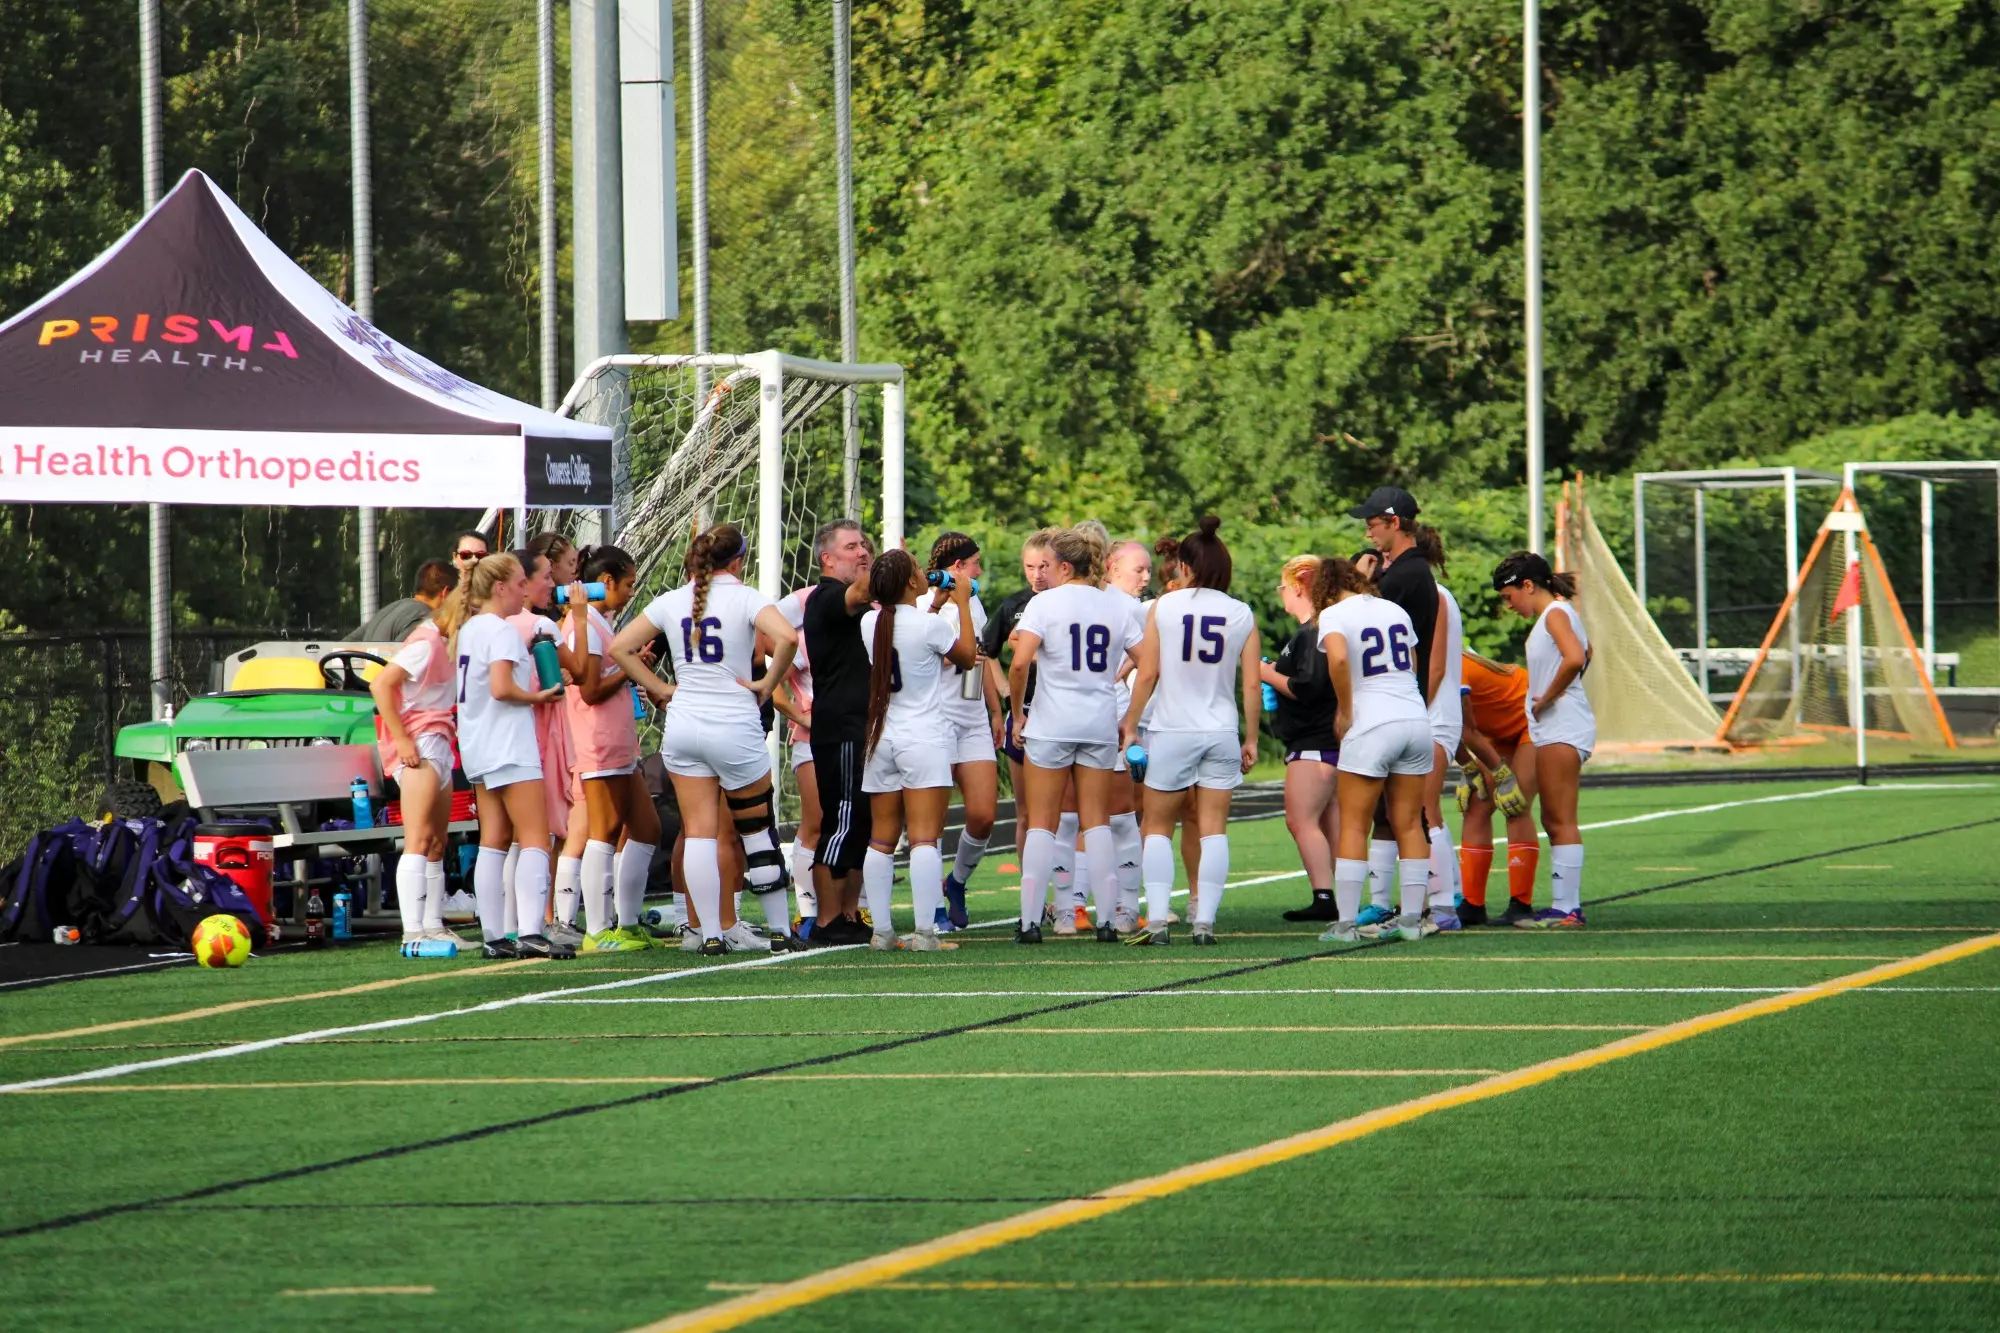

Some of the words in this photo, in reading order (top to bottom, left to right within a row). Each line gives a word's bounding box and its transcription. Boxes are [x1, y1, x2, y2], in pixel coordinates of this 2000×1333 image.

[38, 314, 299, 359] PRISMA
[79, 349, 247, 371] HEALTH
[14, 444, 152, 476] Health
[162, 446, 420, 488] Orthopedics
[681, 616, 723, 663] 16
[1069, 623, 1110, 672] 18
[1182, 614, 1226, 664] 15
[1361, 623, 1411, 677] 26
[459, 655, 470, 703] 7
